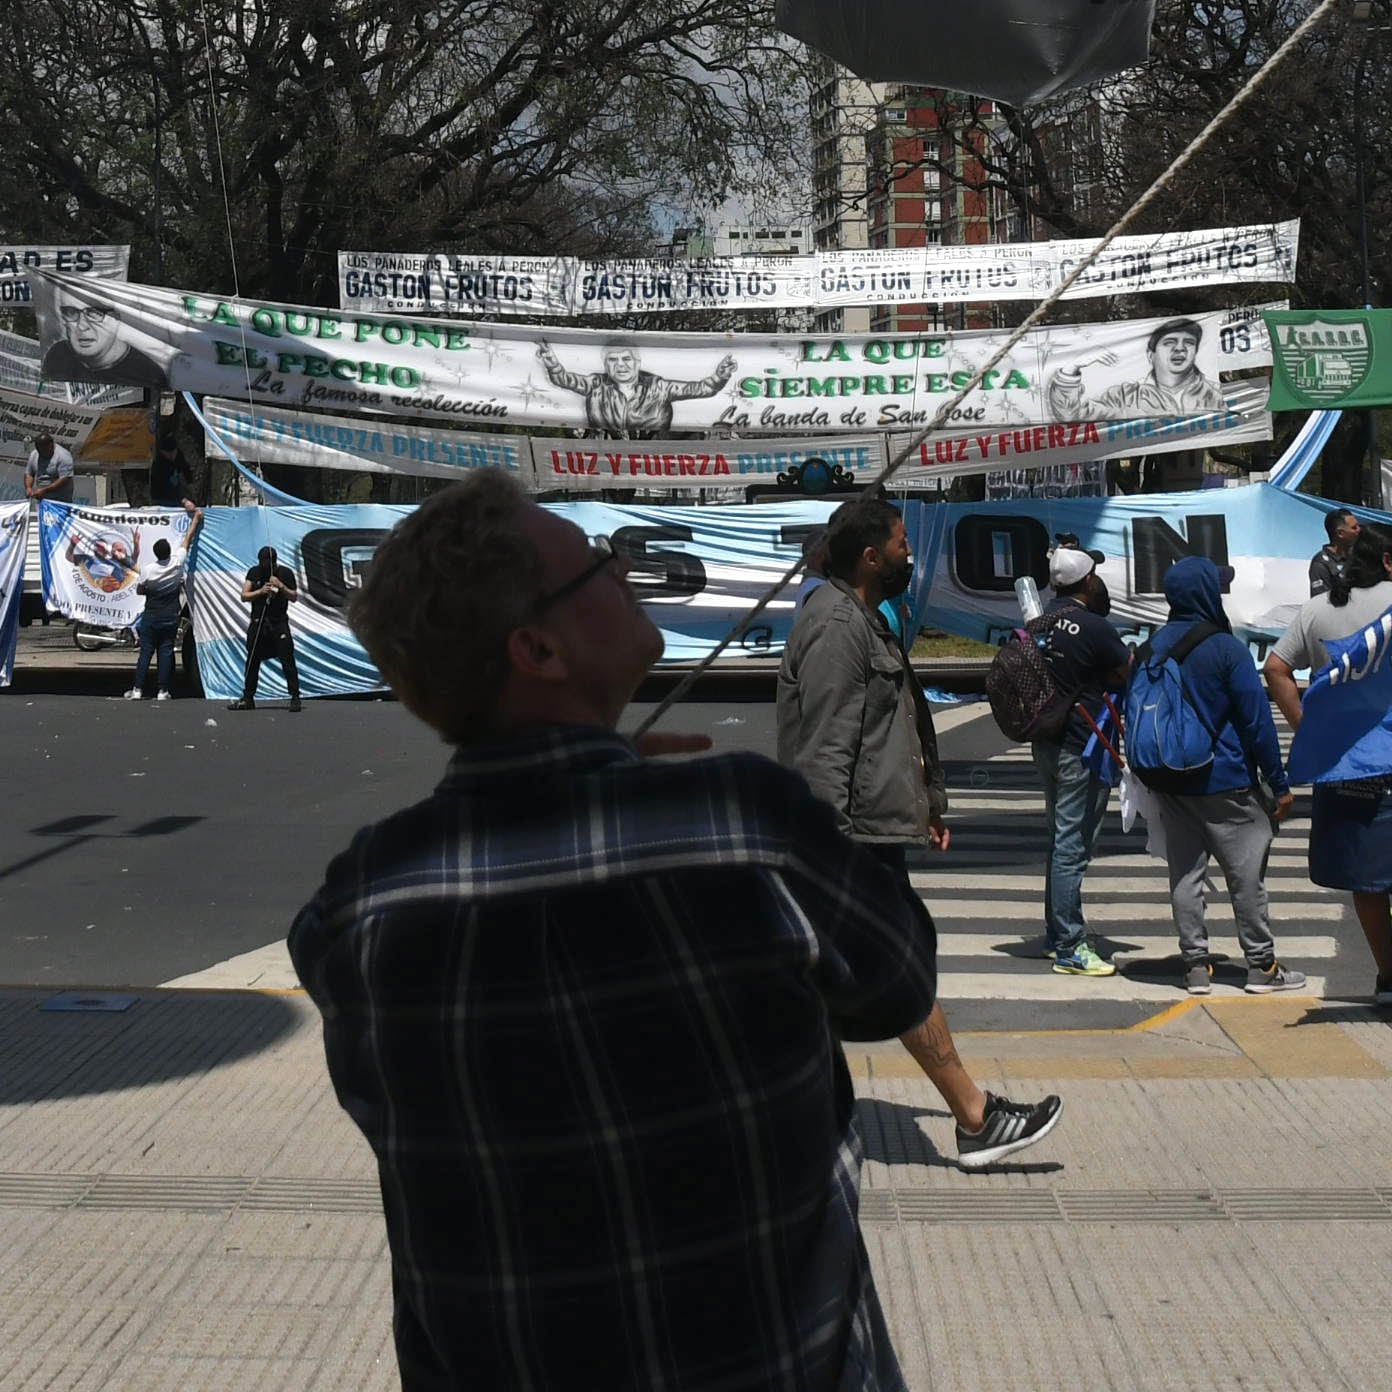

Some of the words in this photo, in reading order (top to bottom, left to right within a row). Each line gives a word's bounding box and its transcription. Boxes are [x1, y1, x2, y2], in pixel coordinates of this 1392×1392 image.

[56, 250, 95, 273] ES
[346, 255, 368, 269] LOS
[374, 258, 441, 272] PANADEROS
[448, 259, 493, 273] LEALES
[511, 260, 551, 274] PERON
[583, 260, 607, 272] LOS
[1164, 243, 1260, 274] FRUTOS
[345, 273, 430, 299] GASTON
[444, 275, 534, 302] FRUTOS
[582, 274, 671, 301] GASTON
[686, 272, 777, 298] FRUTOS
[820, 265, 912, 293] GASTON
[926, 262, 1019, 290] FRUTOS
[181, 296, 241, 326] LA
[252, 308, 342, 339] QUE
[354, 318, 472, 351] PONE
[213, 341, 267, 369] EL
[277, 351, 422, 389] PECHO
[799, 339, 851, 362] LA
[862, 339, 947, 364] QUE
[301, 378, 384, 405] famosa
[390, 390, 509, 419] recolección
[712, 405, 751, 429] La
[760, 404, 831, 427] banda
[840, 404, 868, 426] de
[877, 403, 927, 426] San
[392, 434, 520, 472] PRESENTE
[919, 438, 969, 466] LUZ
[976, 434, 992, 459] Y
[998, 423, 1101, 456] FUERZA
[552, 450, 599, 476] LUZ
[604, 452, 625, 477] Y
[629, 452, 730, 477] FUERZA
[300, 512, 1235, 608] GSON
[79, 584, 106, 603] AGOSTO
[75, 602, 125, 618] PRESENTE
